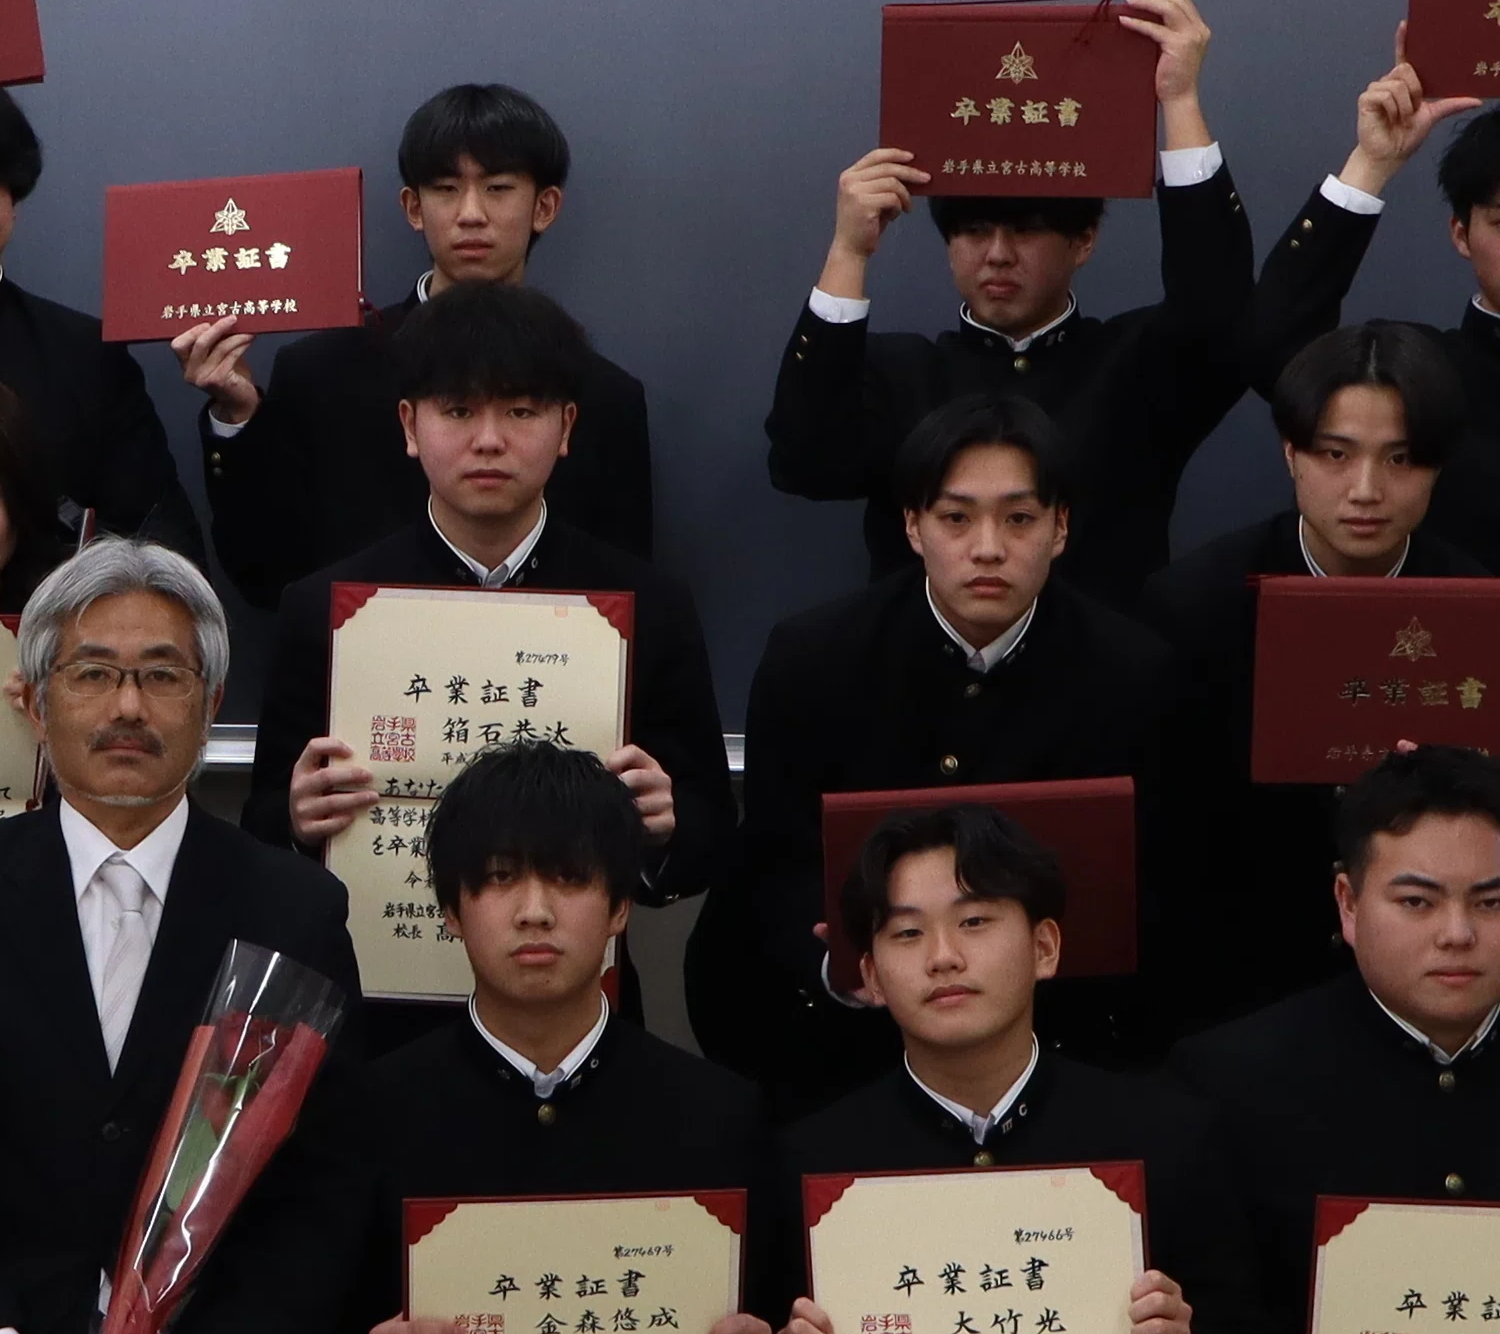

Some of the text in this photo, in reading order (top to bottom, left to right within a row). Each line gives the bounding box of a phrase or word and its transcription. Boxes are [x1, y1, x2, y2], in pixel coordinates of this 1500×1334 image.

[950, 97, 1082, 127] 卒業証書
[168, 242, 292, 275] 卒業証書
[404, 674, 544, 708] 卒業証書
[489, 1270, 646, 1301] 卒業証書
[893, 1257, 1049, 1297] 卒業証書
